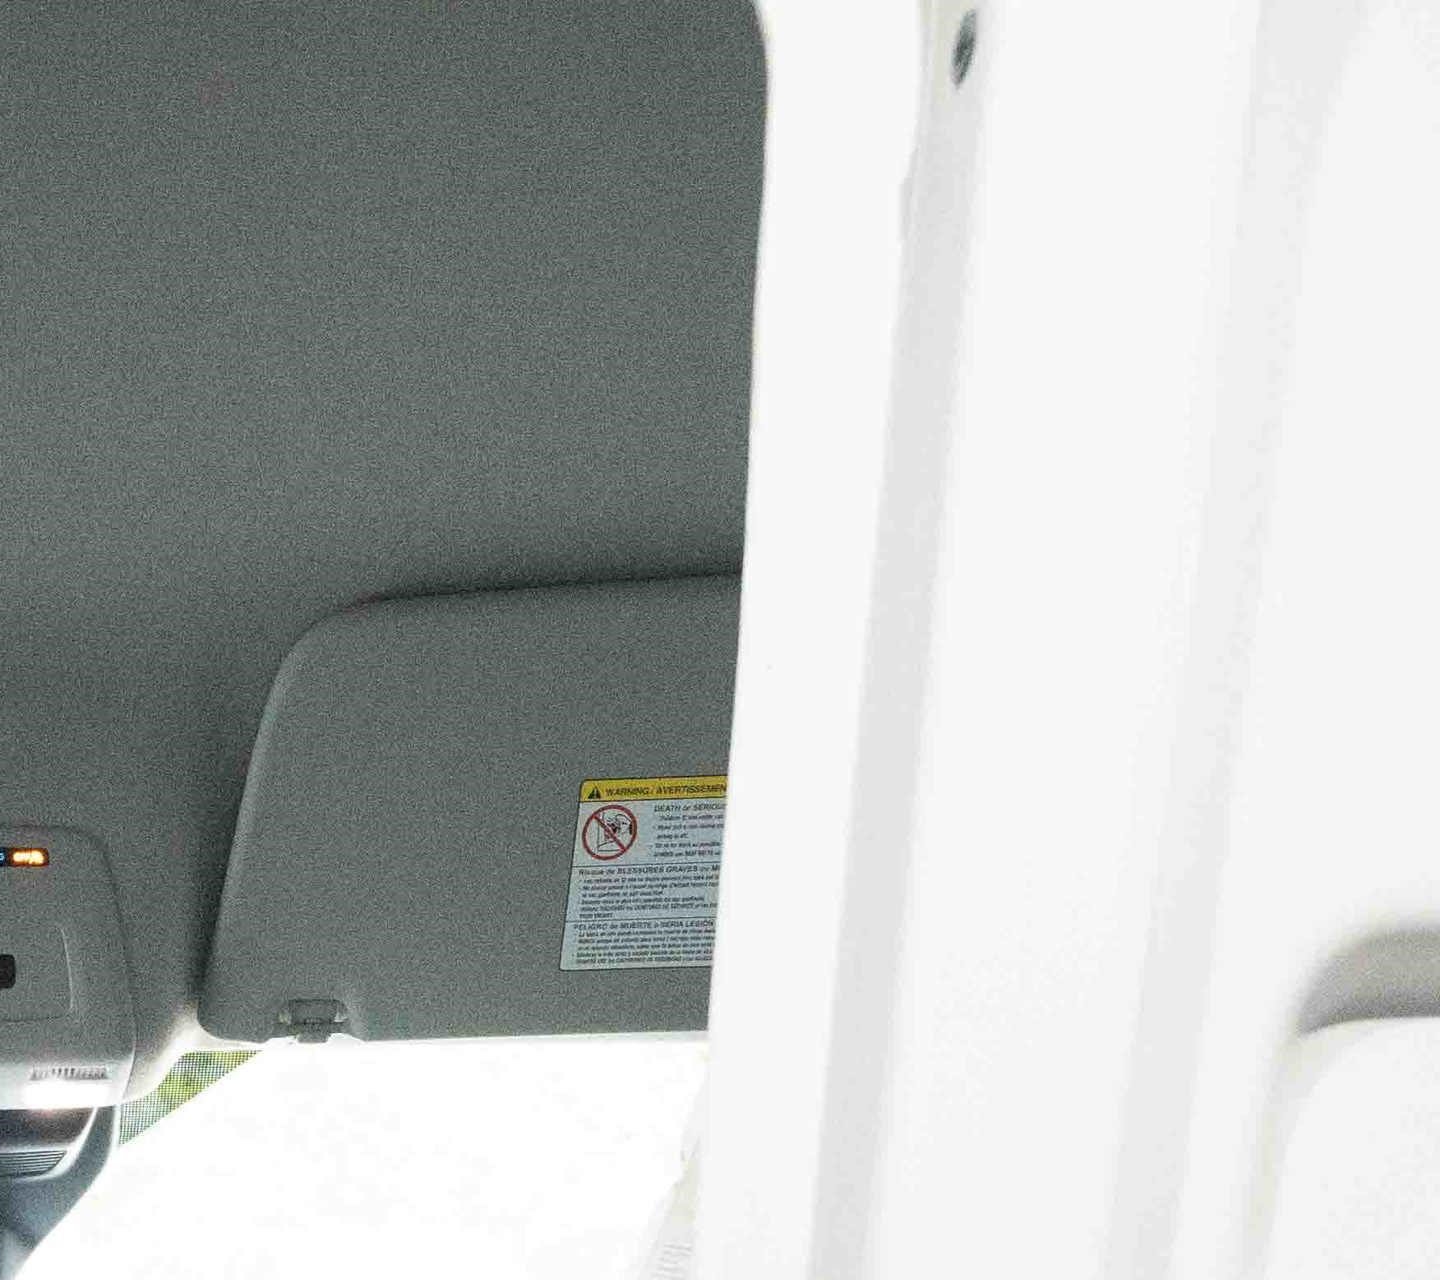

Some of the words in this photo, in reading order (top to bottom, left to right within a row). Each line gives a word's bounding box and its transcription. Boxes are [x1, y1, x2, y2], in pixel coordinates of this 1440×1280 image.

[605, 786, 650, 797] WARNING
[656, 784, 727, 796] AVERTISSEMEN
[693, 802, 727, 811] SERIOU
